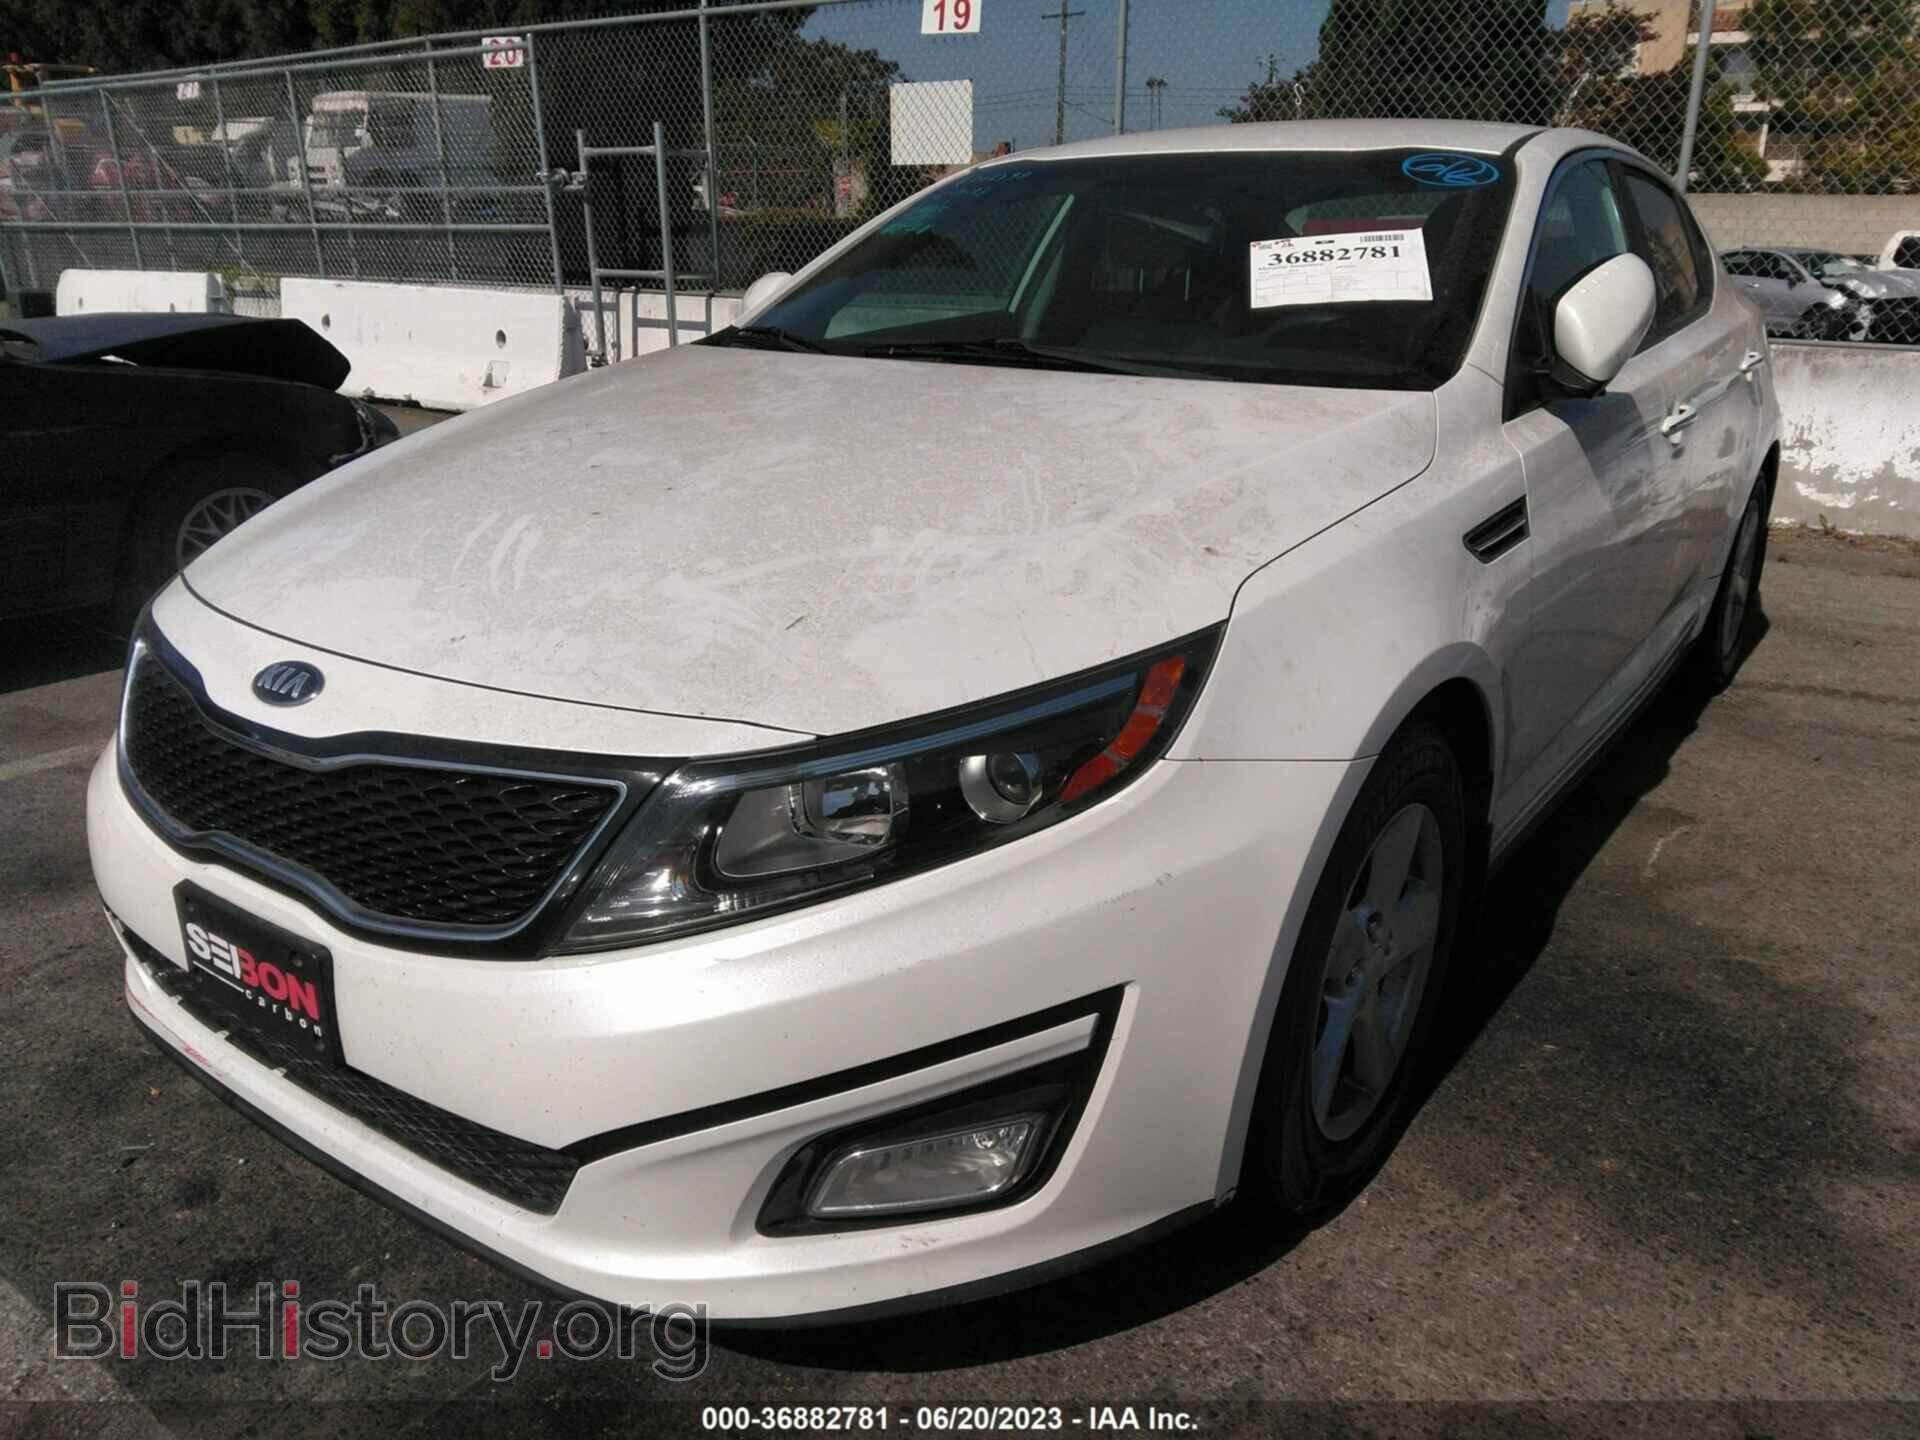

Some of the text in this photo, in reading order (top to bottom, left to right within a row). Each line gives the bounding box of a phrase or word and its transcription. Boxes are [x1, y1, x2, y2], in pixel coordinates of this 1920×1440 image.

[934, 0, 971, 31] 19
[490, 38, 516, 65] 20
[1267, 245, 1400, 266] 36882781
[257, 664, 310, 698] KIA
[186, 922, 320, 1021] SEIBON
[245, 989, 323, 1038] carbon
